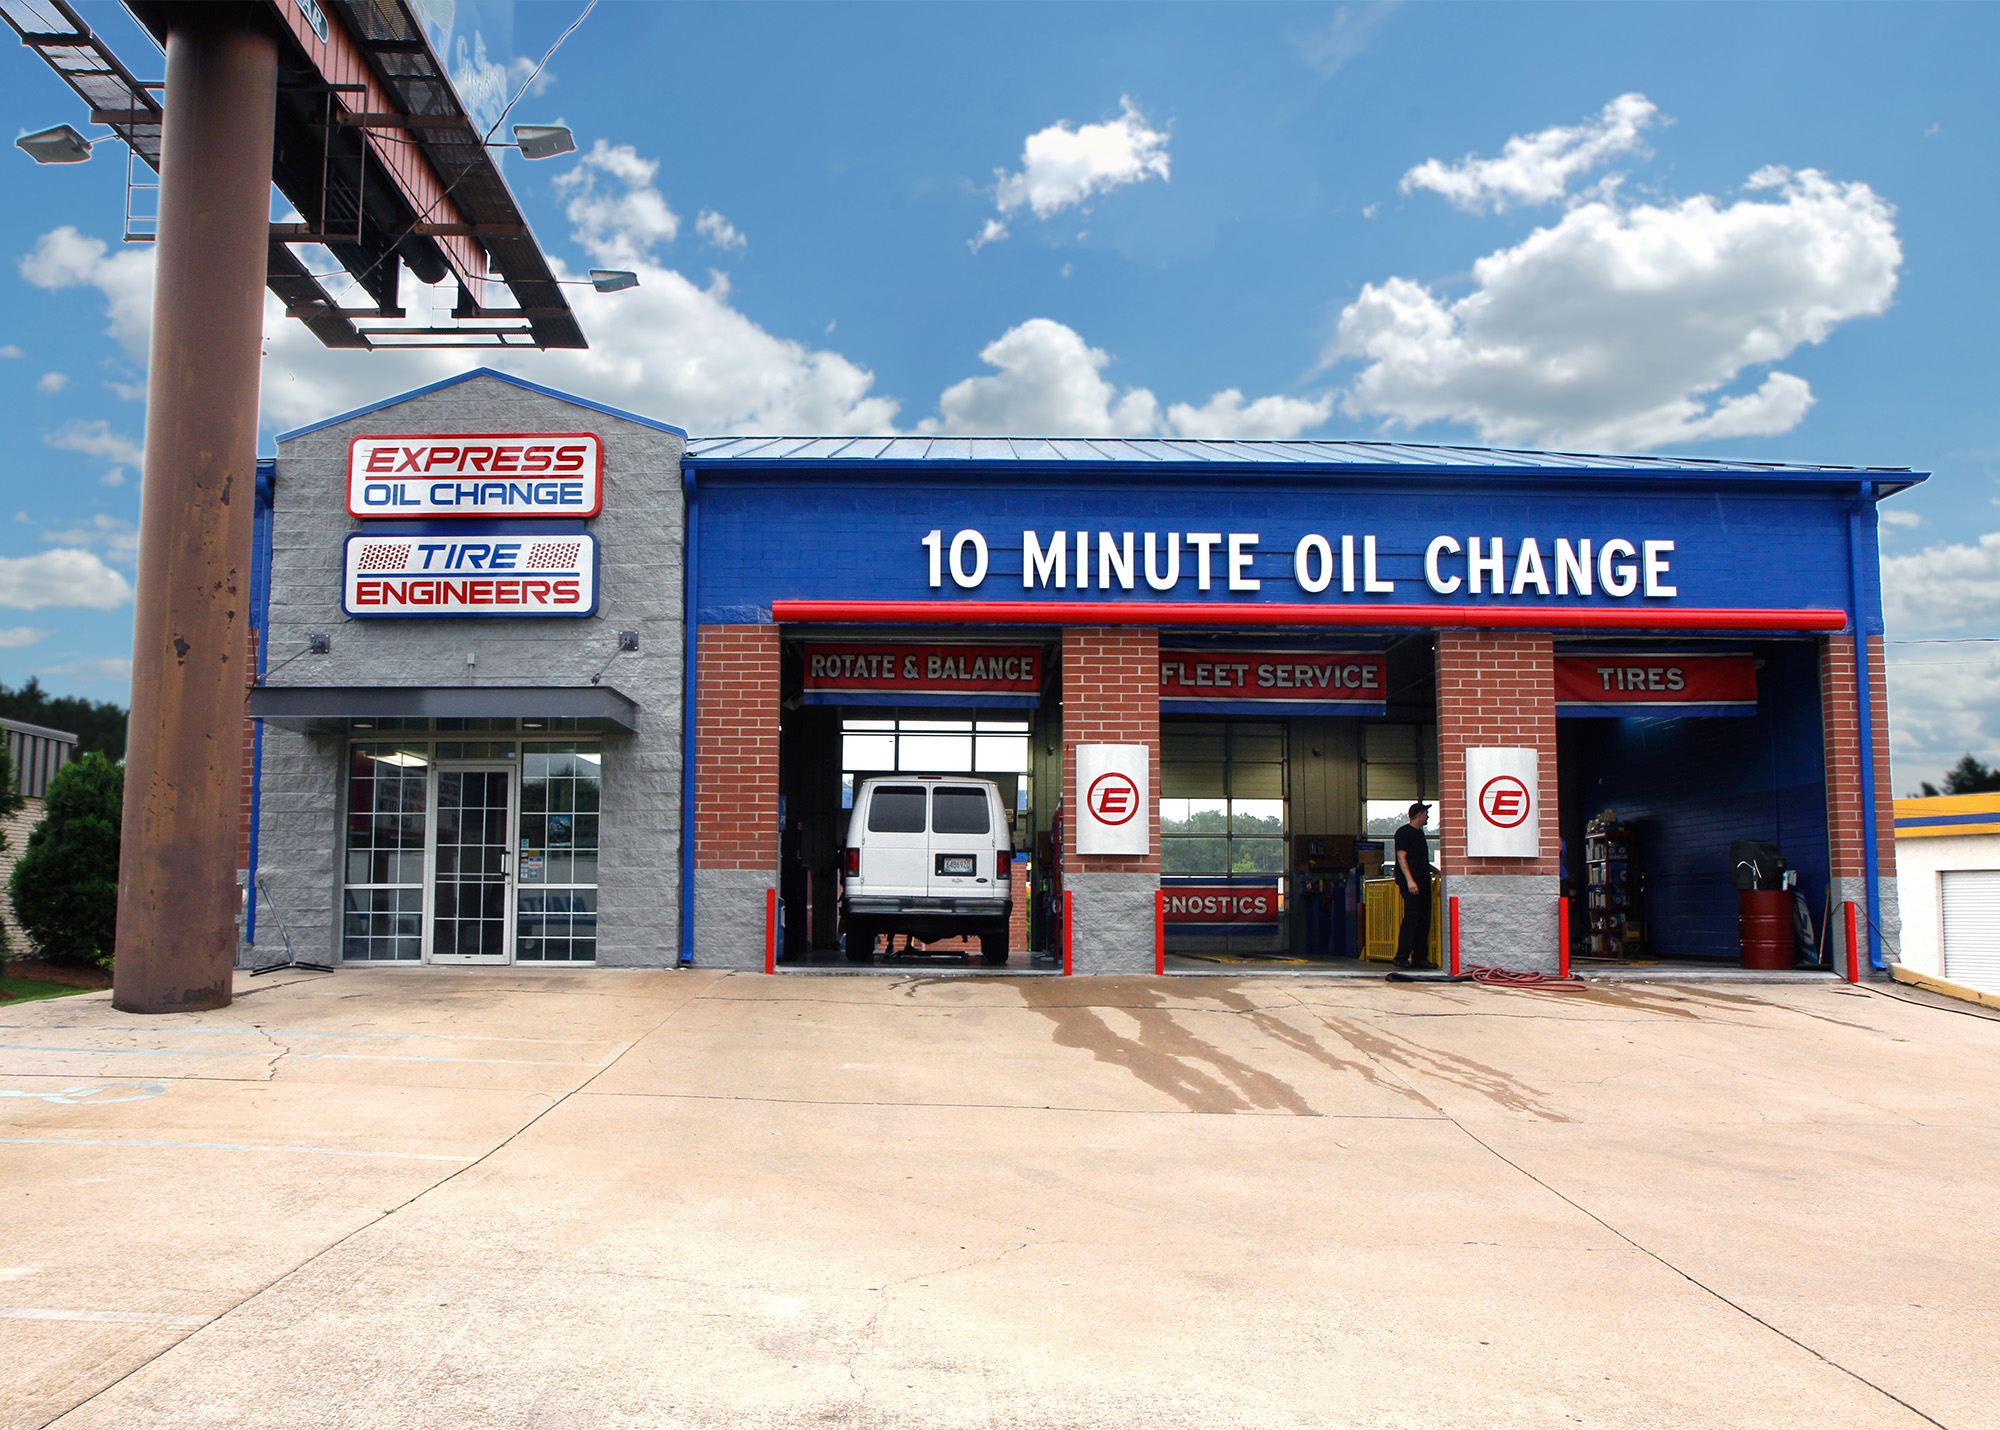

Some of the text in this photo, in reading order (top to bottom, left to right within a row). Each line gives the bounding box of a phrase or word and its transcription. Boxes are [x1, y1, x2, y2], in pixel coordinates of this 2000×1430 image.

[364, 445, 588, 473] EXPRESS
[364, 482, 584, 506] OIL CHANGE
[417, 543, 523, 570] TIRE
[921, 529, 1678, 598] 10 MINUTE OIL CHANGE
[355, 580, 581, 606] ENGINEERS
[810, 654, 1034, 681] ROTATE & BALANCE
[1160, 662, 1379, 689] FLEET SERVICE
[1596, 667, 1686, 691] TIRES
[1098, 787, 1132, 813] E
[1491, 790, 1523, 816] E
